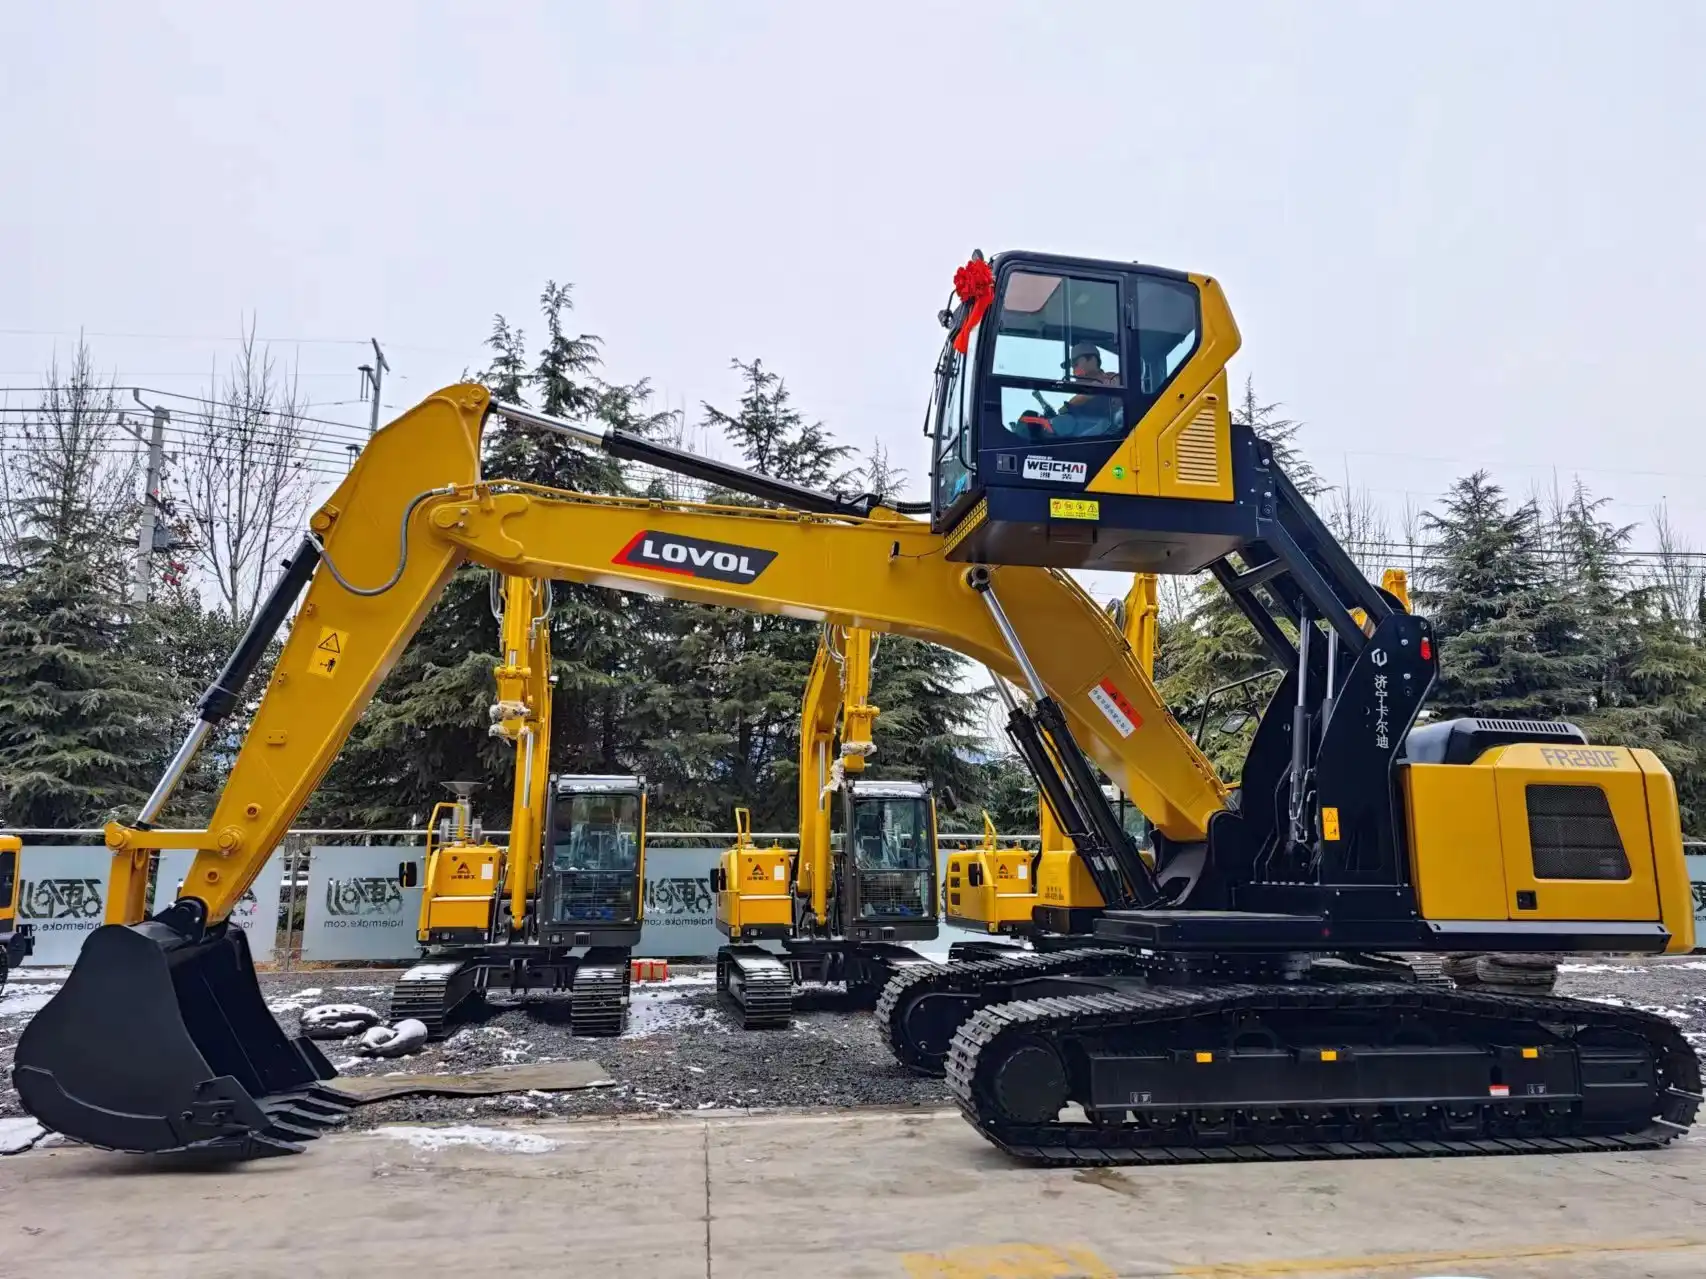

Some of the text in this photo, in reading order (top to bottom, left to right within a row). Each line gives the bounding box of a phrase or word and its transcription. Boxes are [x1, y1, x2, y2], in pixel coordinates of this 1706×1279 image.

[1027, 461, 1084, 474] WEICHAI
[642, 540, 755, 575] LOVOL
[1374, 674, 1389, 749] 济宁卡尔迪
[1540, 748, 1619, 769] FR260F
